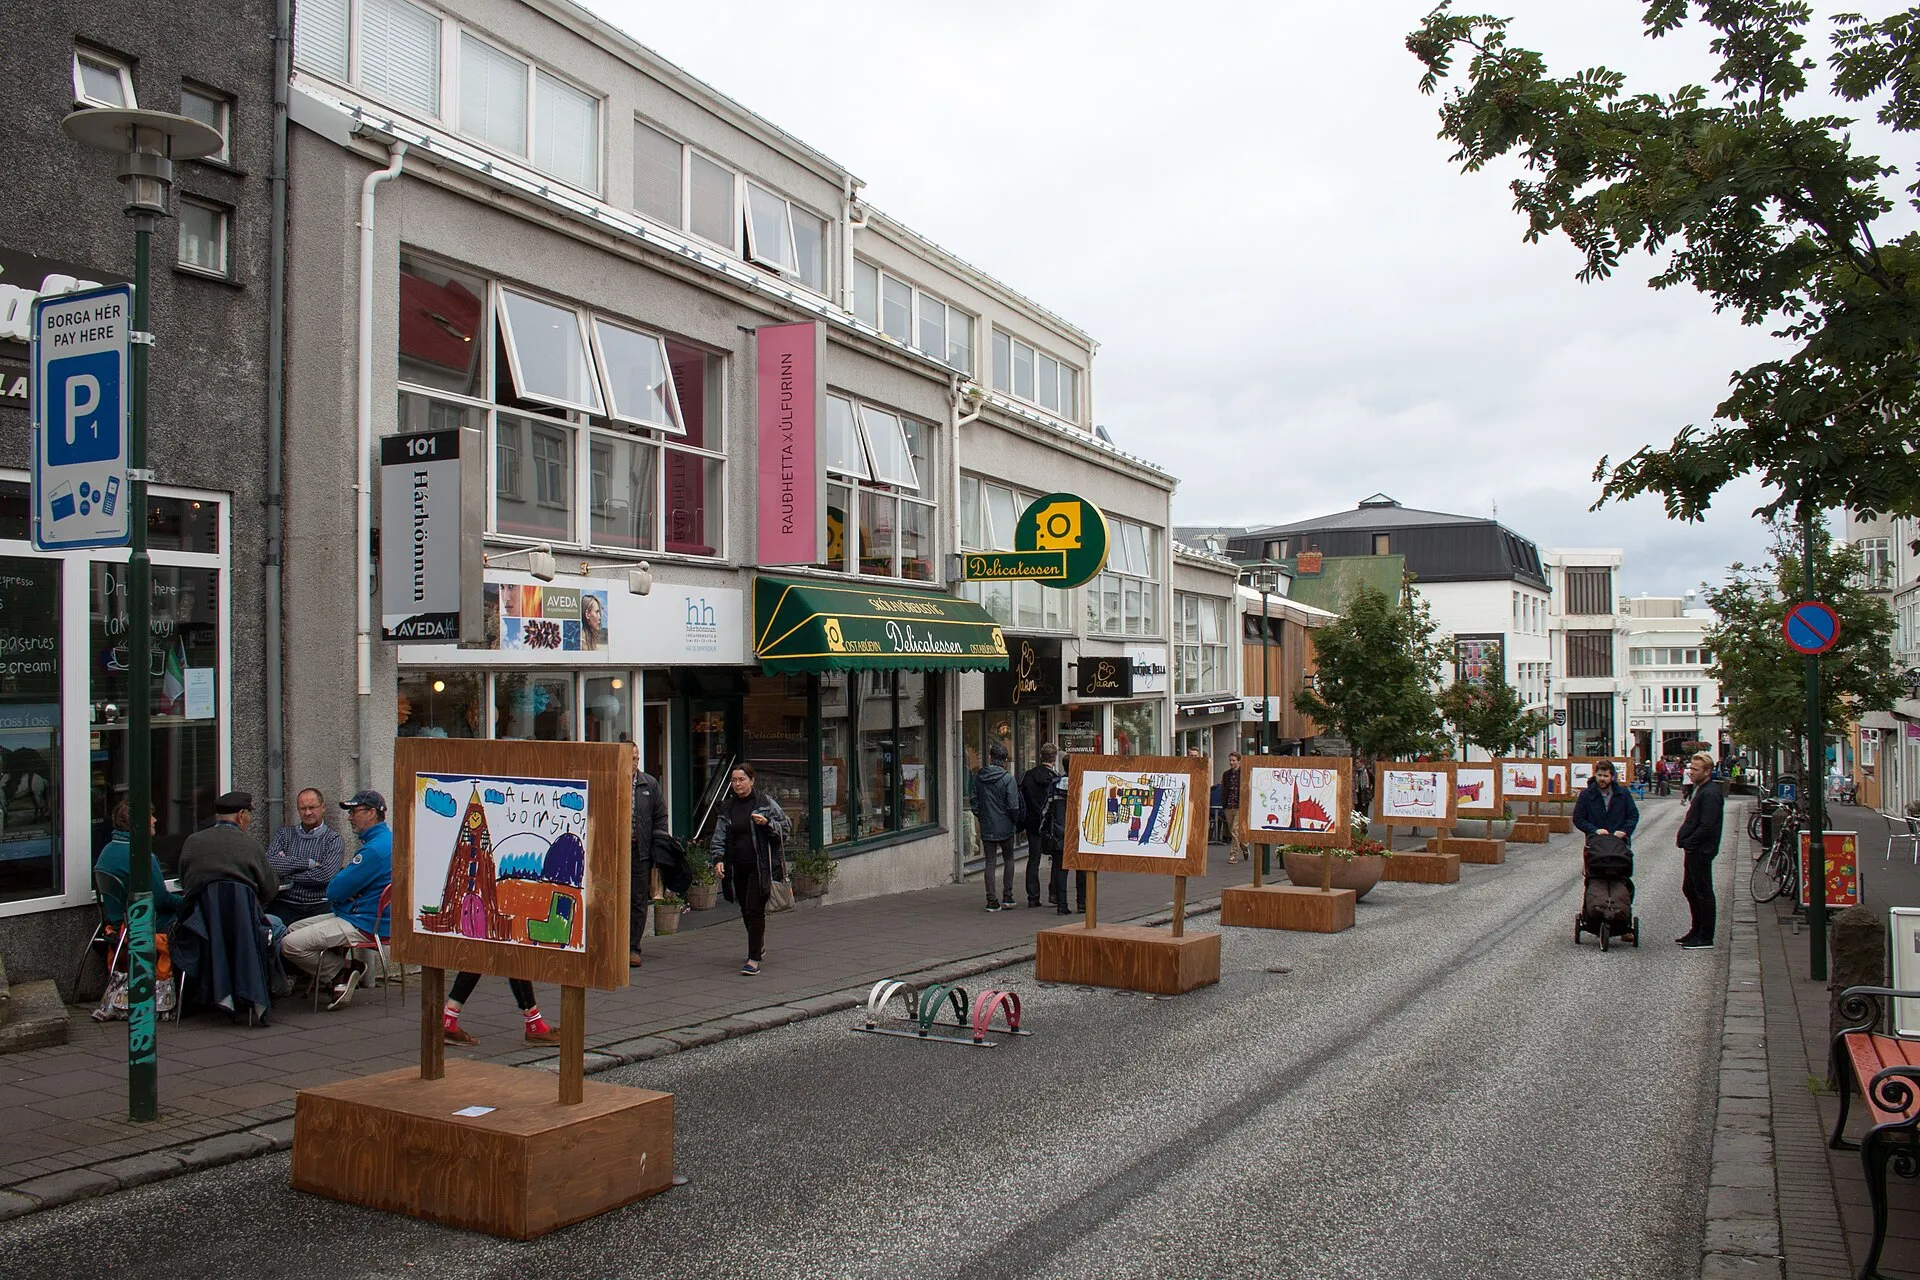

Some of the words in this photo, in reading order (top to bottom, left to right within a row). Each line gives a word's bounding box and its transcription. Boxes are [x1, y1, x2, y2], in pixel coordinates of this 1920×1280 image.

[47, 310, 91, 330] BORGA
[95, 303, 121, 321] HÉR
[54, 331, 76, 348] PAY
[80, 325, 114, 344] HERE
[778, 352, 793, 432] ÚLFURINN
[64, 373, 101, 445] P
[90, 419, 98, 439] 1
[406, 436, 437, 457] 101
[413, 470, 430, 603] Hárhönnun
[969, 556, 1062, 578] Delicatessen
[104, 572, 129, 597] Dri
[153, 579, 177, 597] here
[546, 595, 578, 609] AVEDA
[685, 597, 717, 626] hh
[398, 620, 446, 638] AVEDA
[885, 620, 964, 654] Delicatessen
[845, 641, 883, 653] OSTABÚÐIN
[9, 658, 57, 676] cream!
[505, 786, 560, 810] ALMA
[1784, 785, 1791, 793] P
